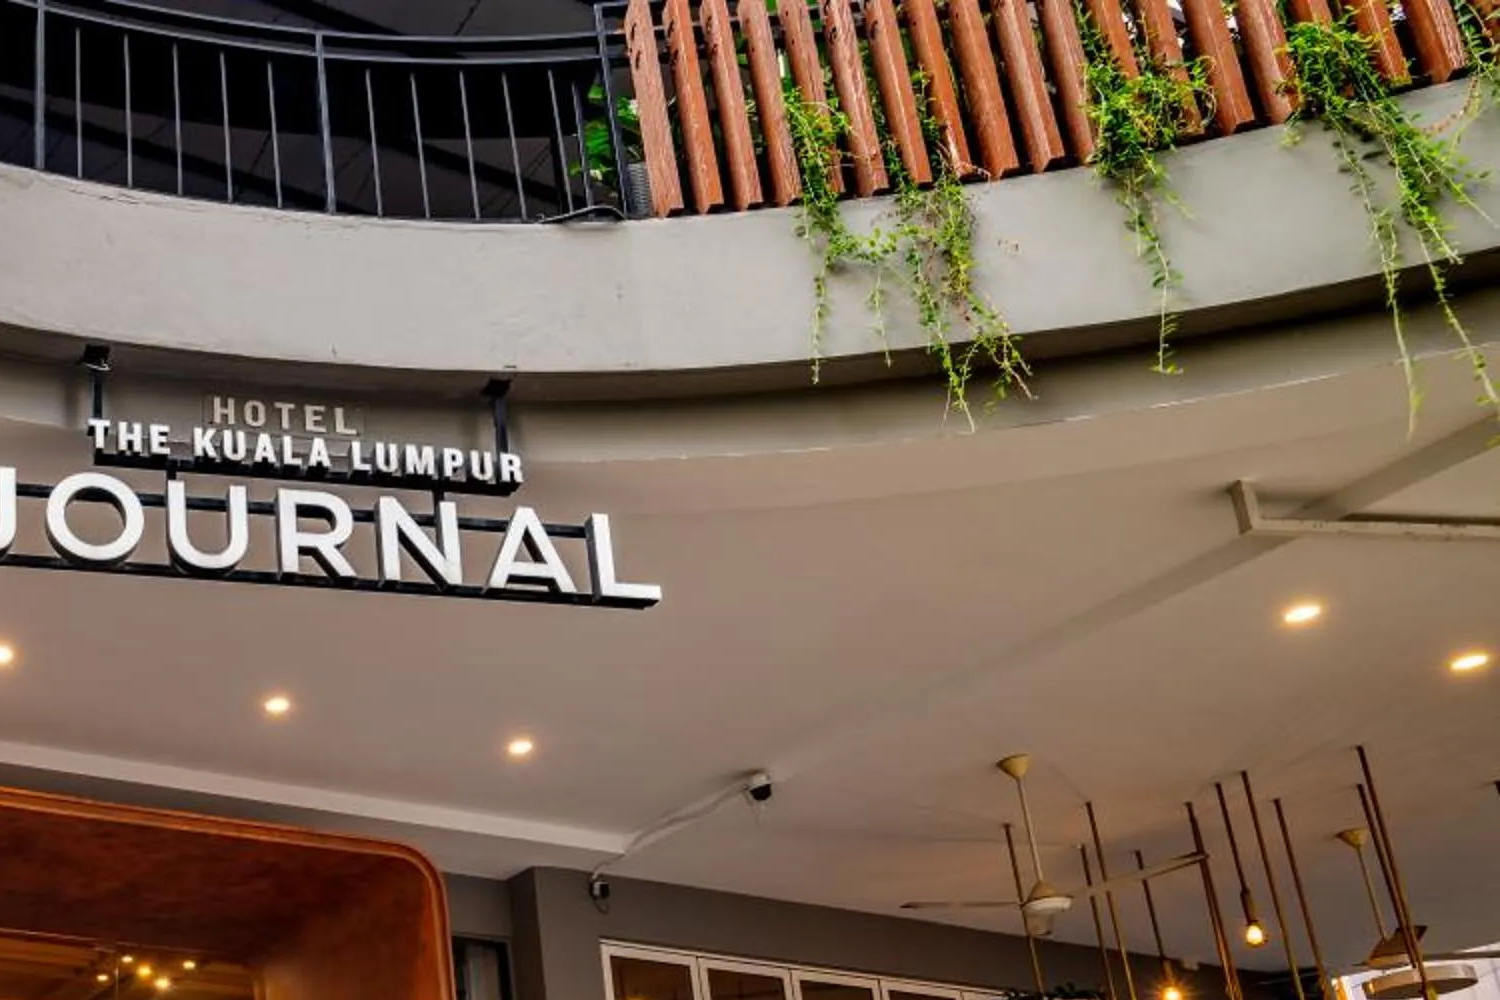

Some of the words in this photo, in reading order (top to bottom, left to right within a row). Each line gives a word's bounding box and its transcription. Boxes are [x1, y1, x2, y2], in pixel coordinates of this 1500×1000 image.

[212, 396, 358, 435] HOTEL
[87, 418, 171, 457] THE
[193, 427, 331, 468] KUALA
[351, 440, 524, 483] LUMPUR
